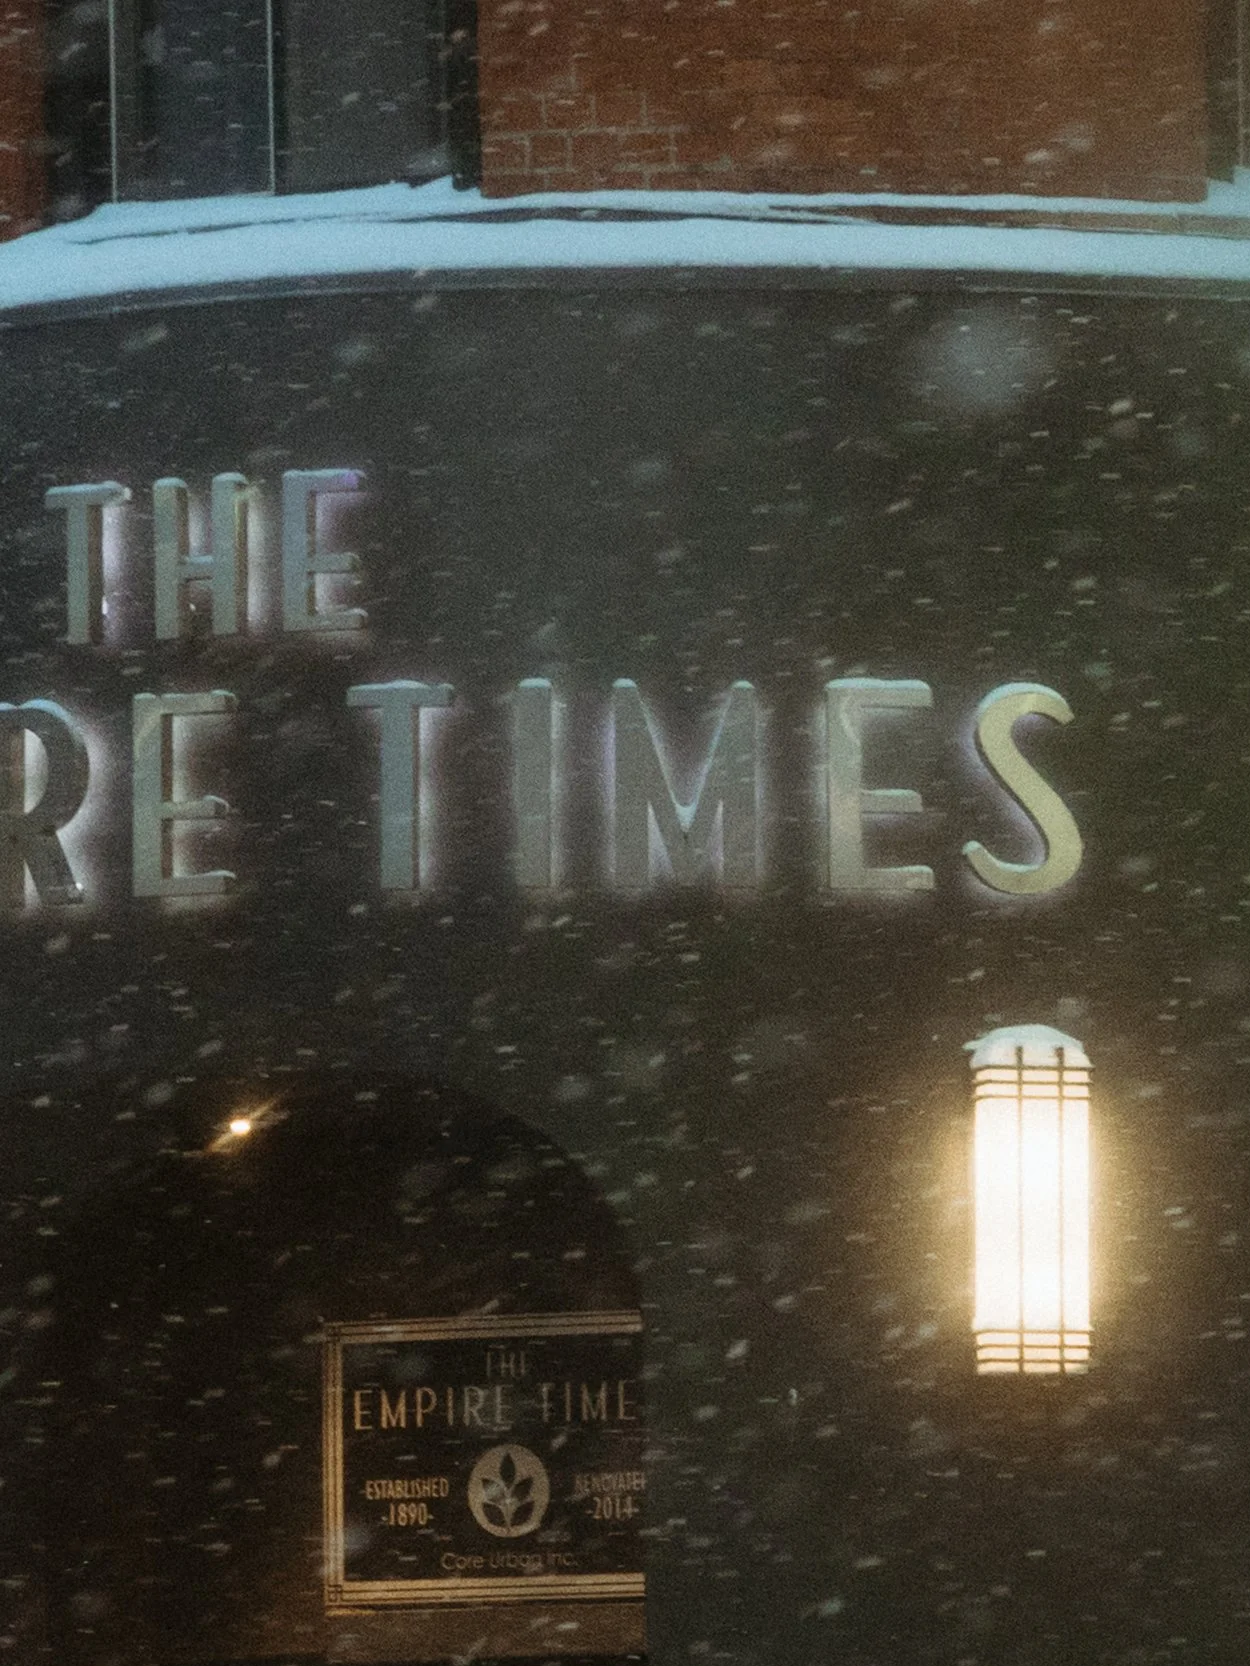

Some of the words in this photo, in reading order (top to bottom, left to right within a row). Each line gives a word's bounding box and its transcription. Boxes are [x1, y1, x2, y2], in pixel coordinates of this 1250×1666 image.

[45, 467, 369, 646] THE
[346, 677, 1084, 896] TIMES
[354, 1384, 514, 1430] EMPIRE
[540, 1379, 637, 1423] TIME
[365, 1476, 450, 1500] ESTABLISHED
[441, 1552, 485, 1570] Core
